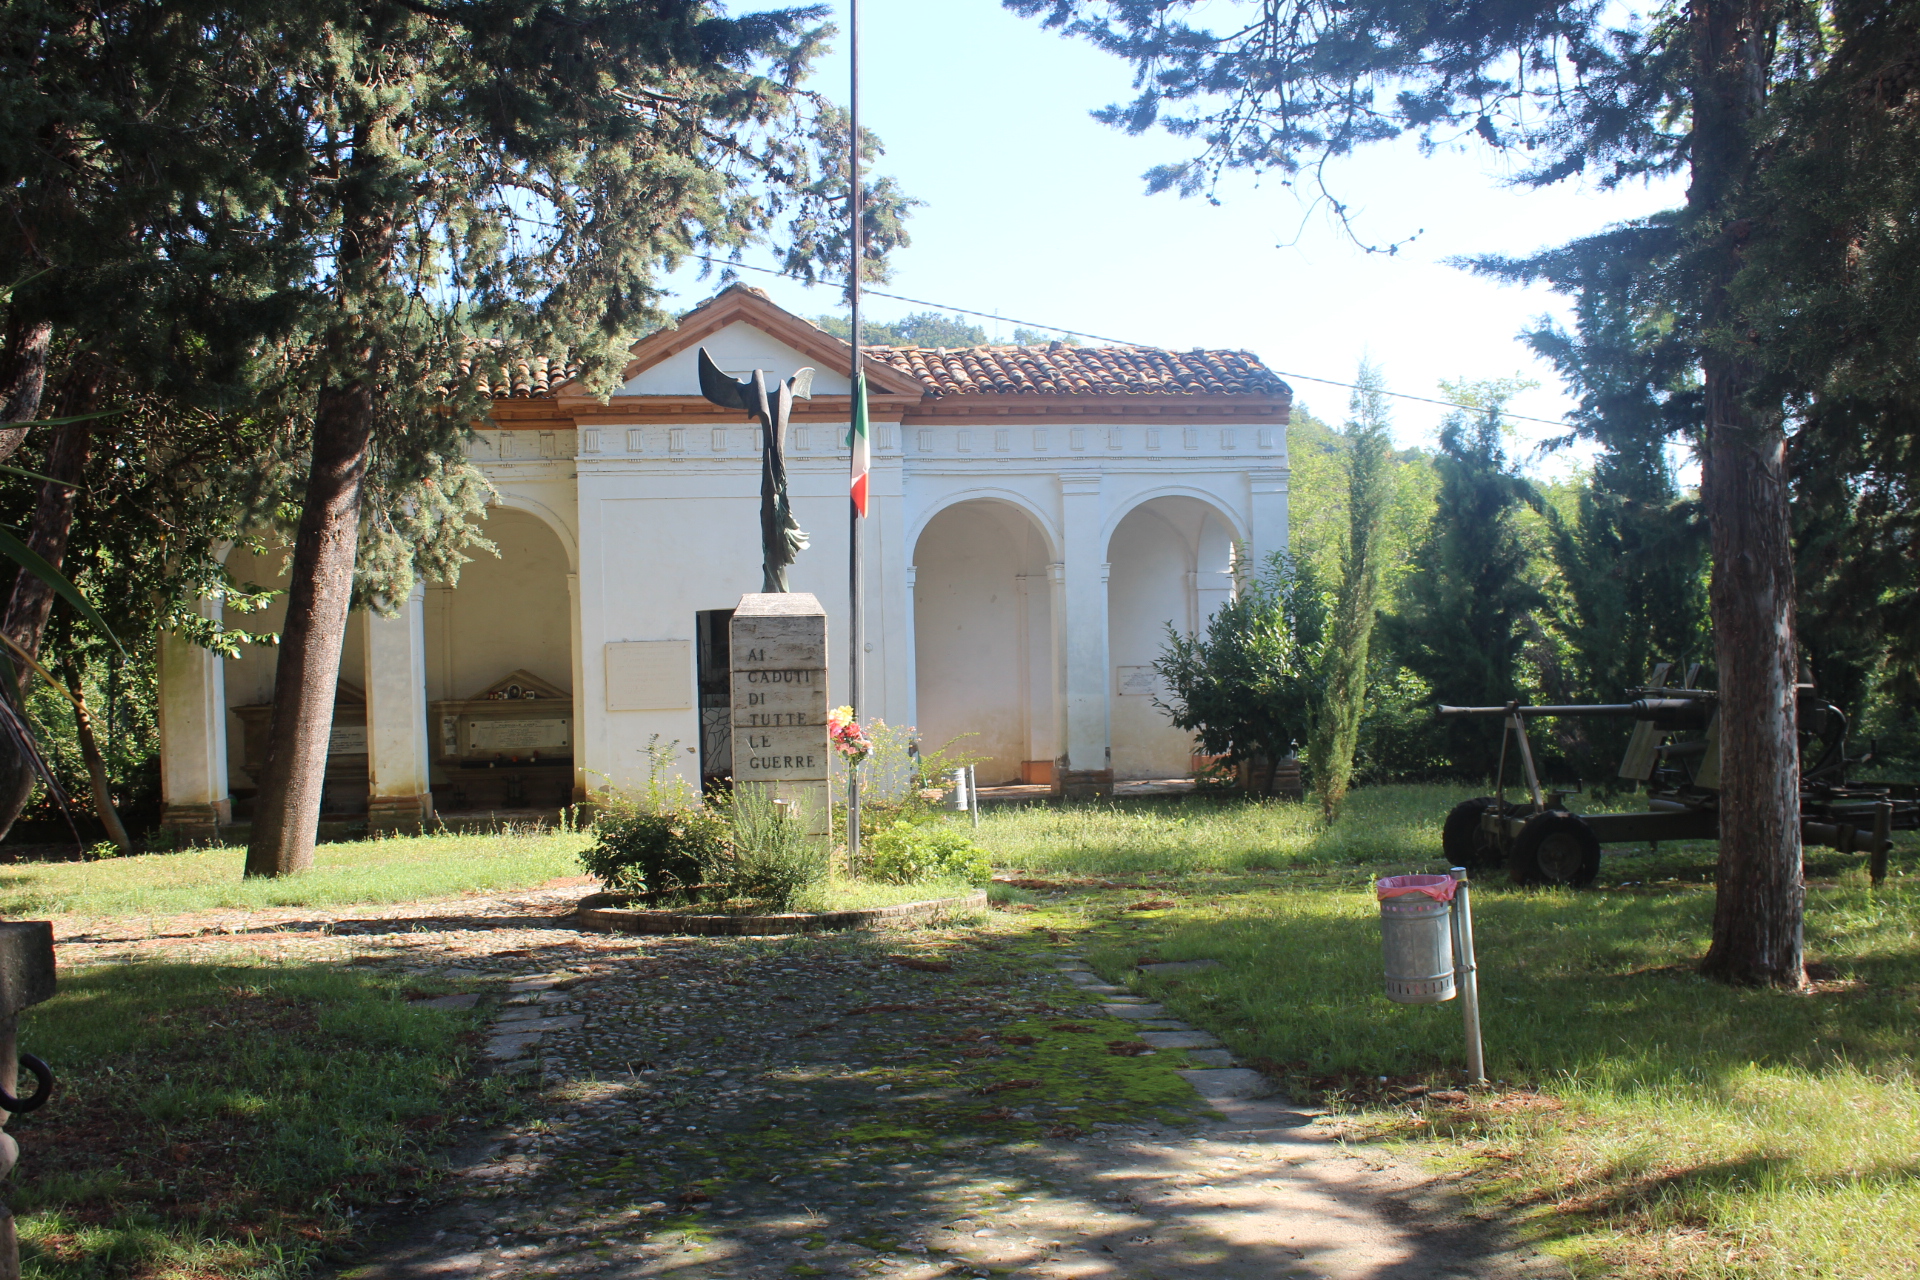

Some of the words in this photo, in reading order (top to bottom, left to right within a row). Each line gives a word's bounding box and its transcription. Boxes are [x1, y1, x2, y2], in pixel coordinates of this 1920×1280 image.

[748, 649, 764, 661] AI
[748, 671, 809, 683] CADUTI
[749, 693, 764, 705] DI
[750, 713, 807, 726] TUTTE
[750, 735, 771, 748] LE
[750, 756, 815, 769] GUERRE
